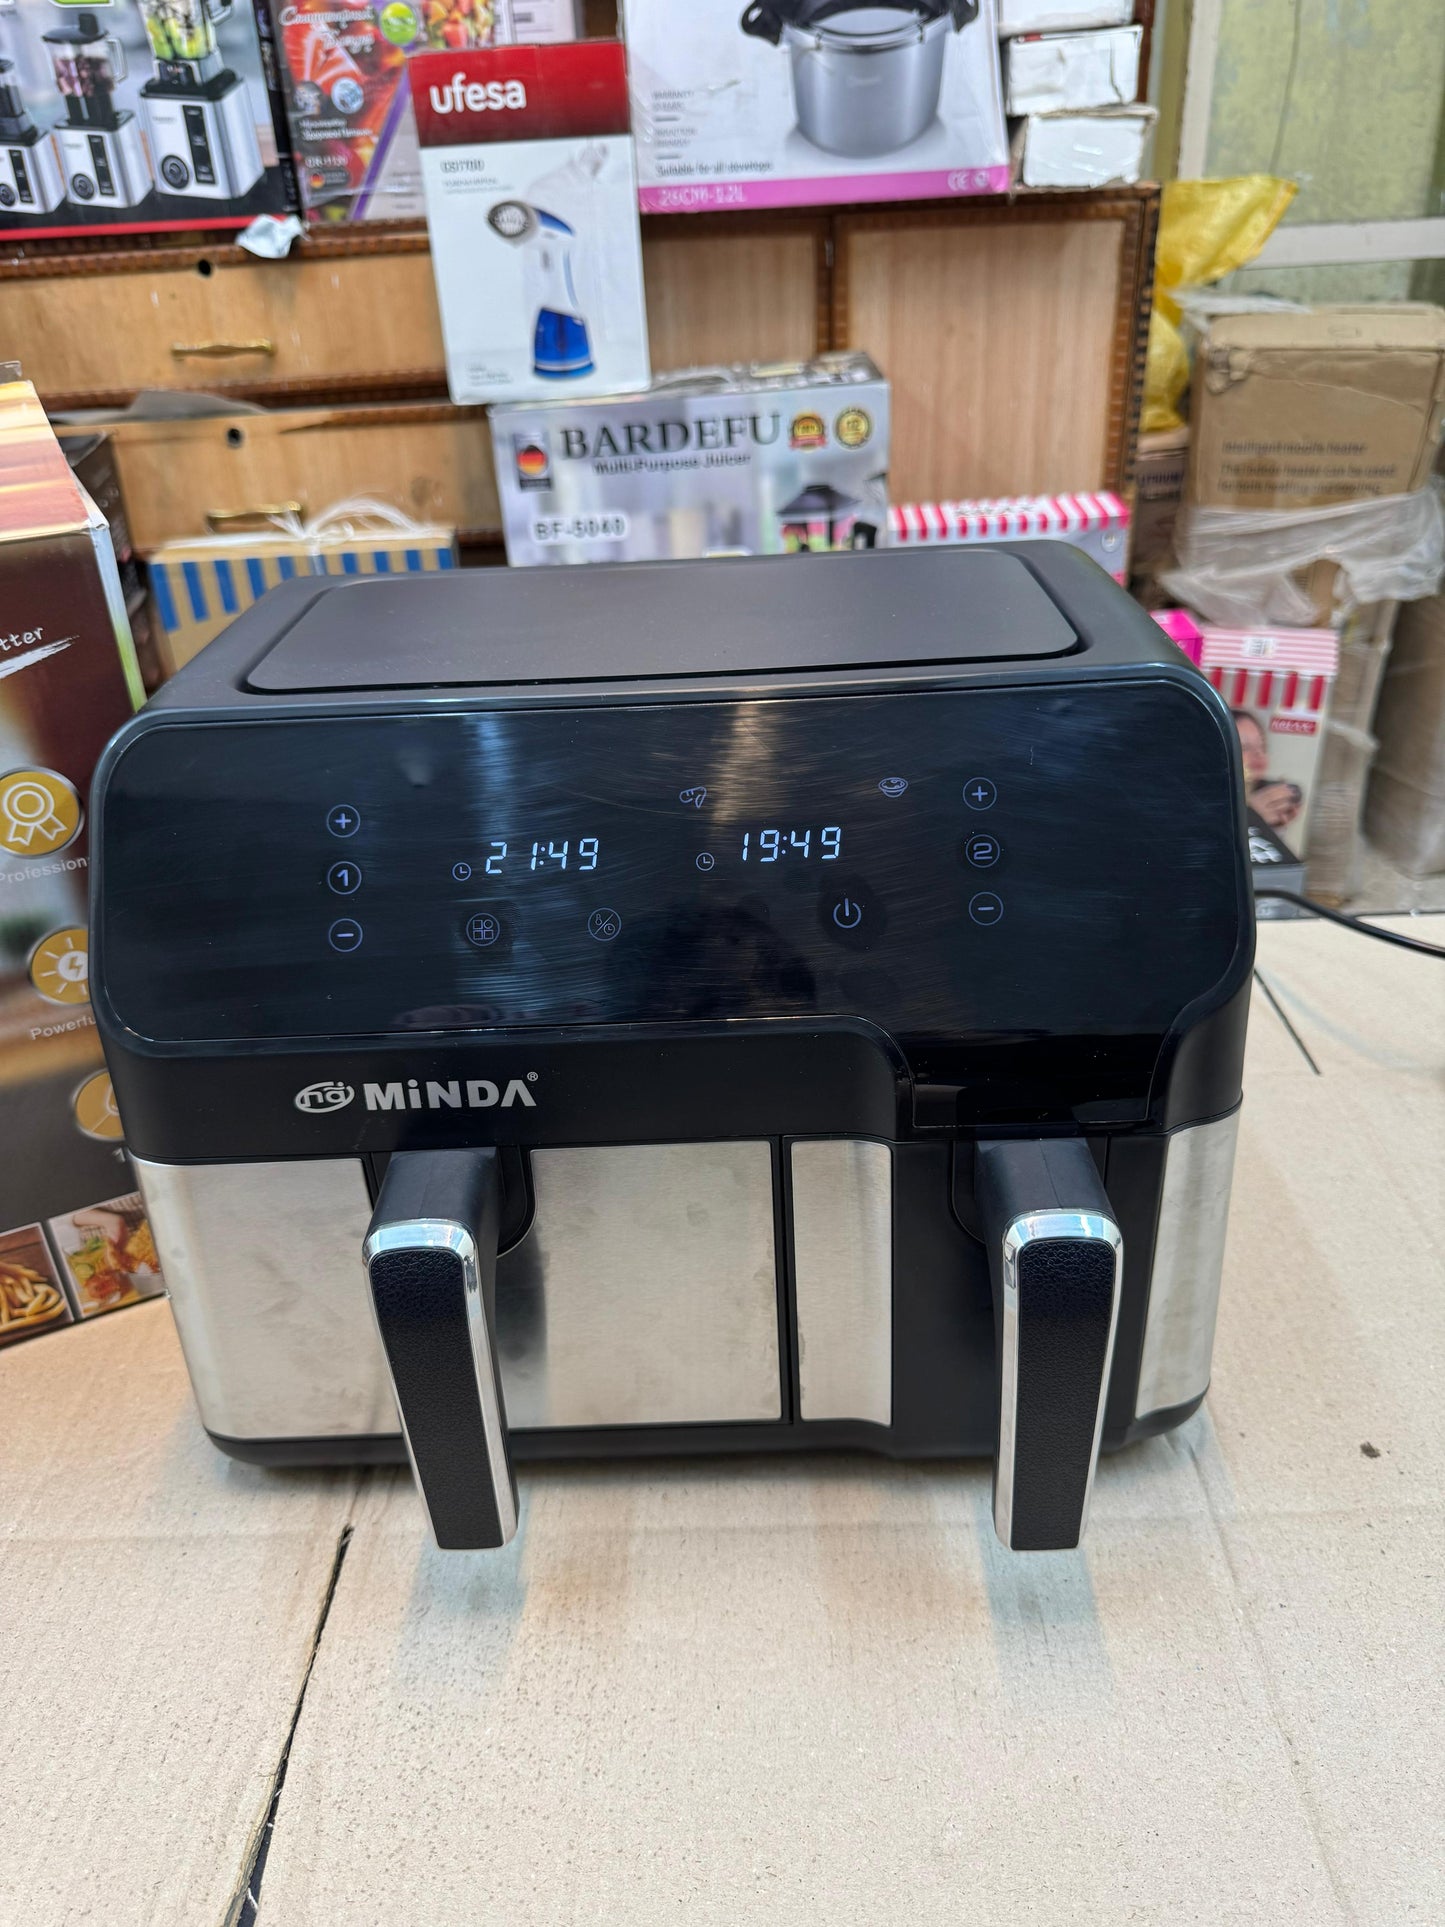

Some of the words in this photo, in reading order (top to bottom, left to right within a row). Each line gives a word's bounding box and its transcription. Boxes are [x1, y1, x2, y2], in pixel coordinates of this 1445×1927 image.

[429, 72, 527, 115] ufesa
[560, 414, 781, 460] BARDEFU
[484, 837, 600, 875] 21:49
[741, 826, 842, 862] 19:49
[973, 842, 994, 861] 2
[336, 868, 349, 887] 1
